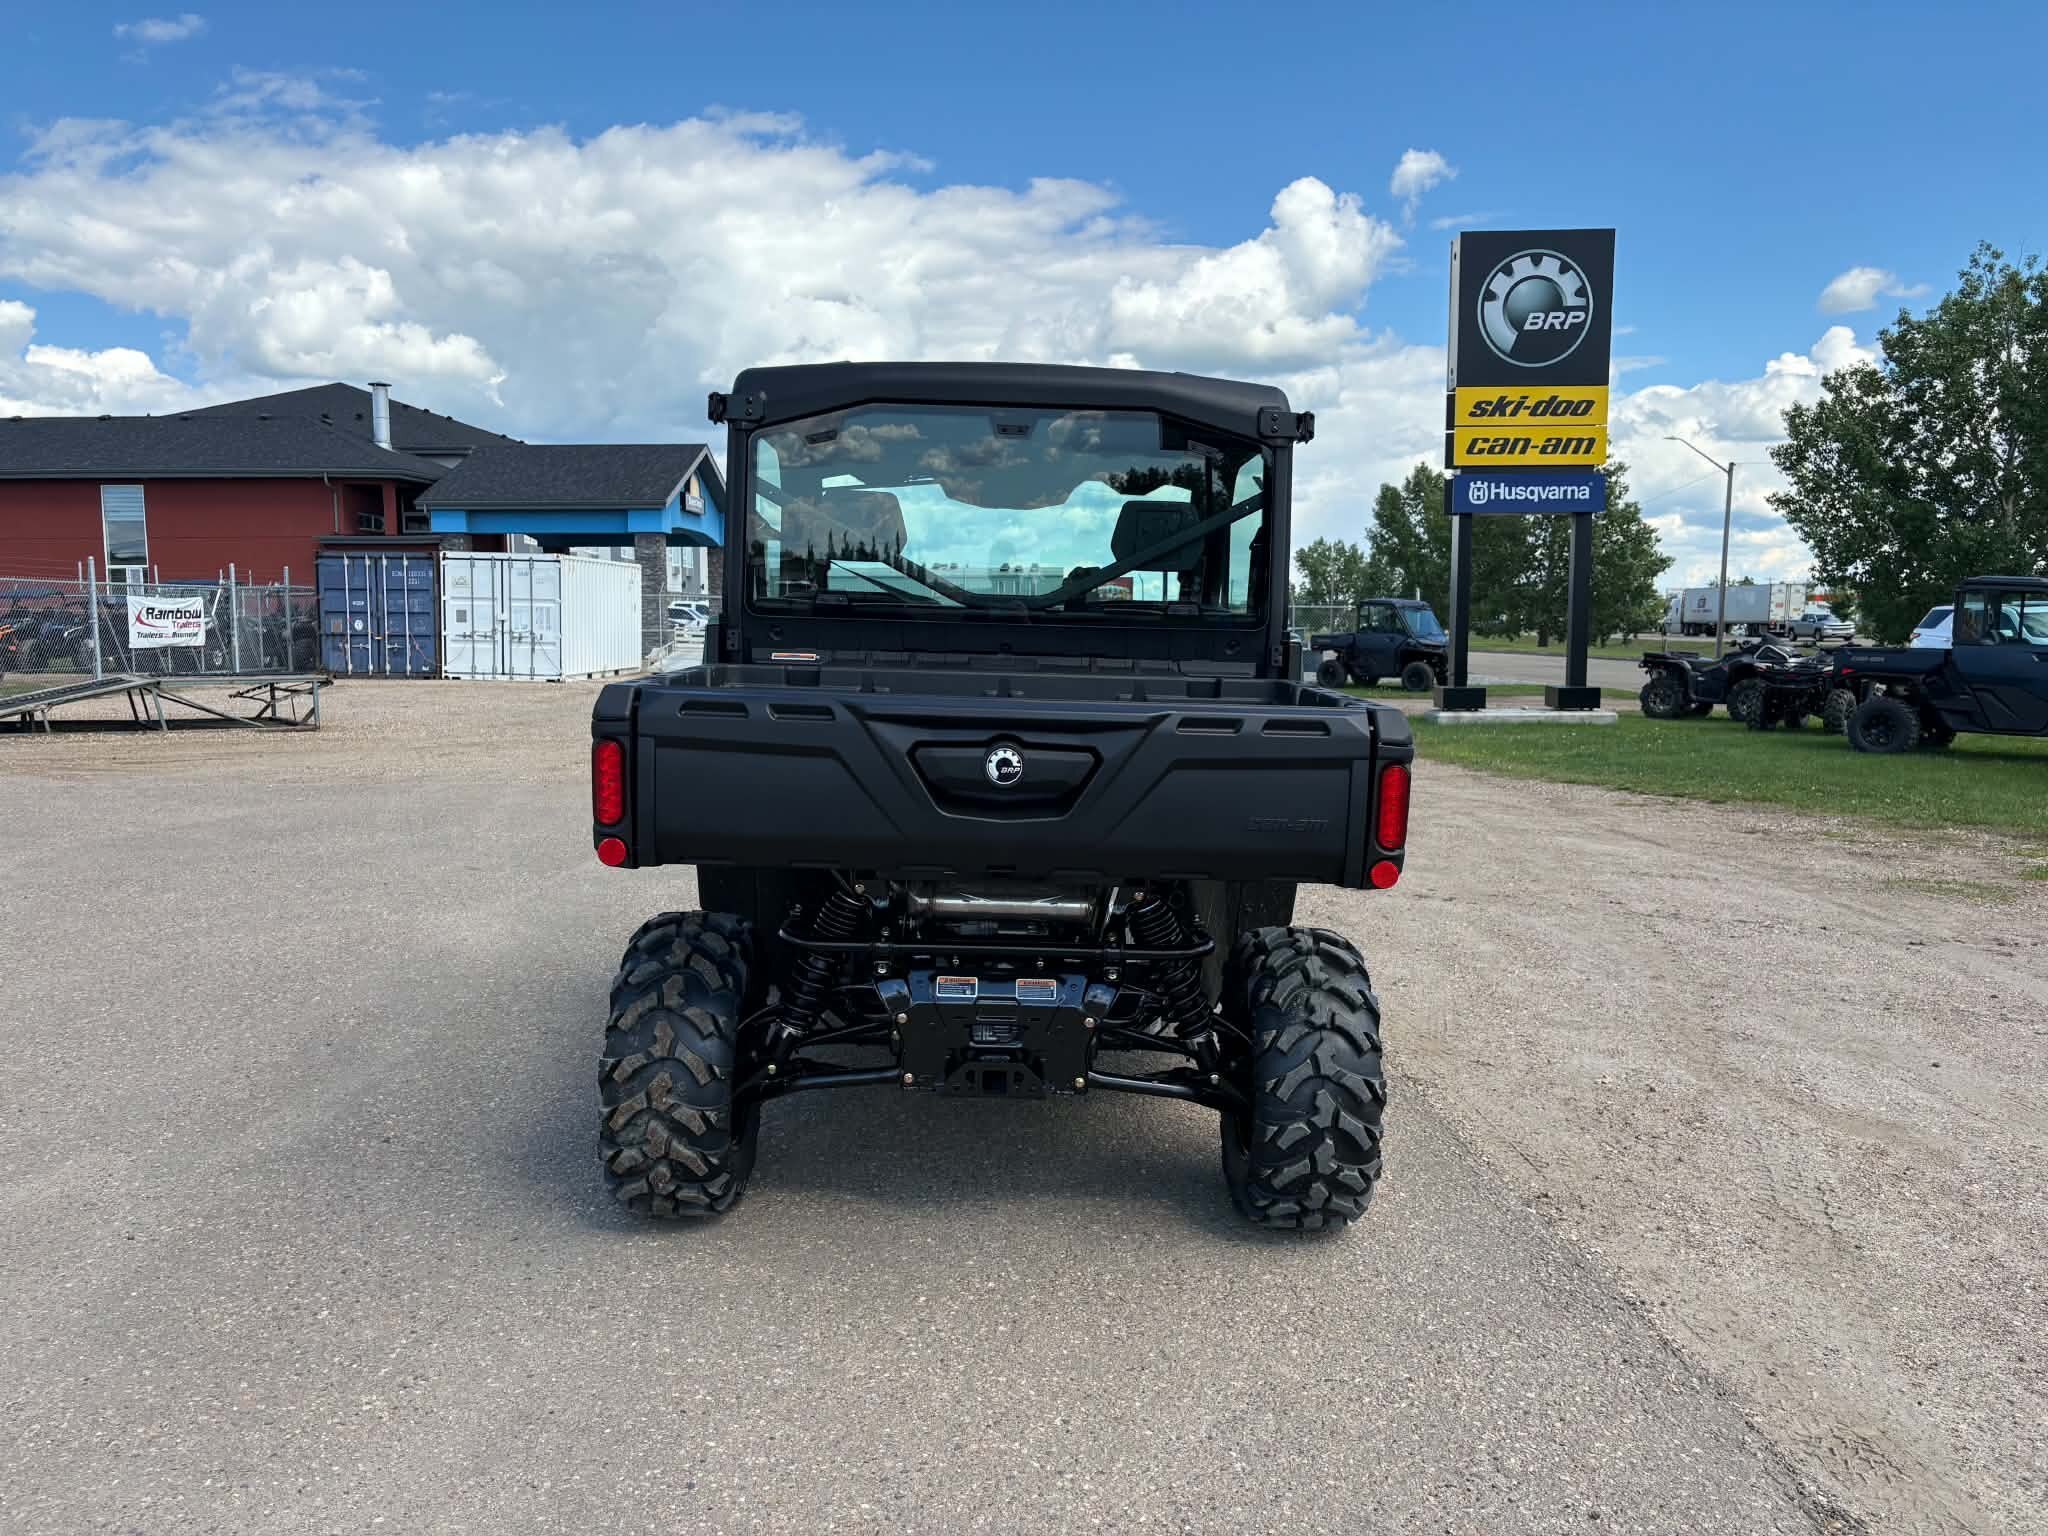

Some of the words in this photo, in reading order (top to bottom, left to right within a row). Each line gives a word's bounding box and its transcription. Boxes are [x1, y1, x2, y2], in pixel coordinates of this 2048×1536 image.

[1523, 311, 1586, 330] BRP
[1468, 395, 1596, 418] ski-doo
[1466, 437, 1597, 455] can-am
[1490, 482, 1590, 502] Husqvarna
[146, 608, 201, 619] Rainbow
